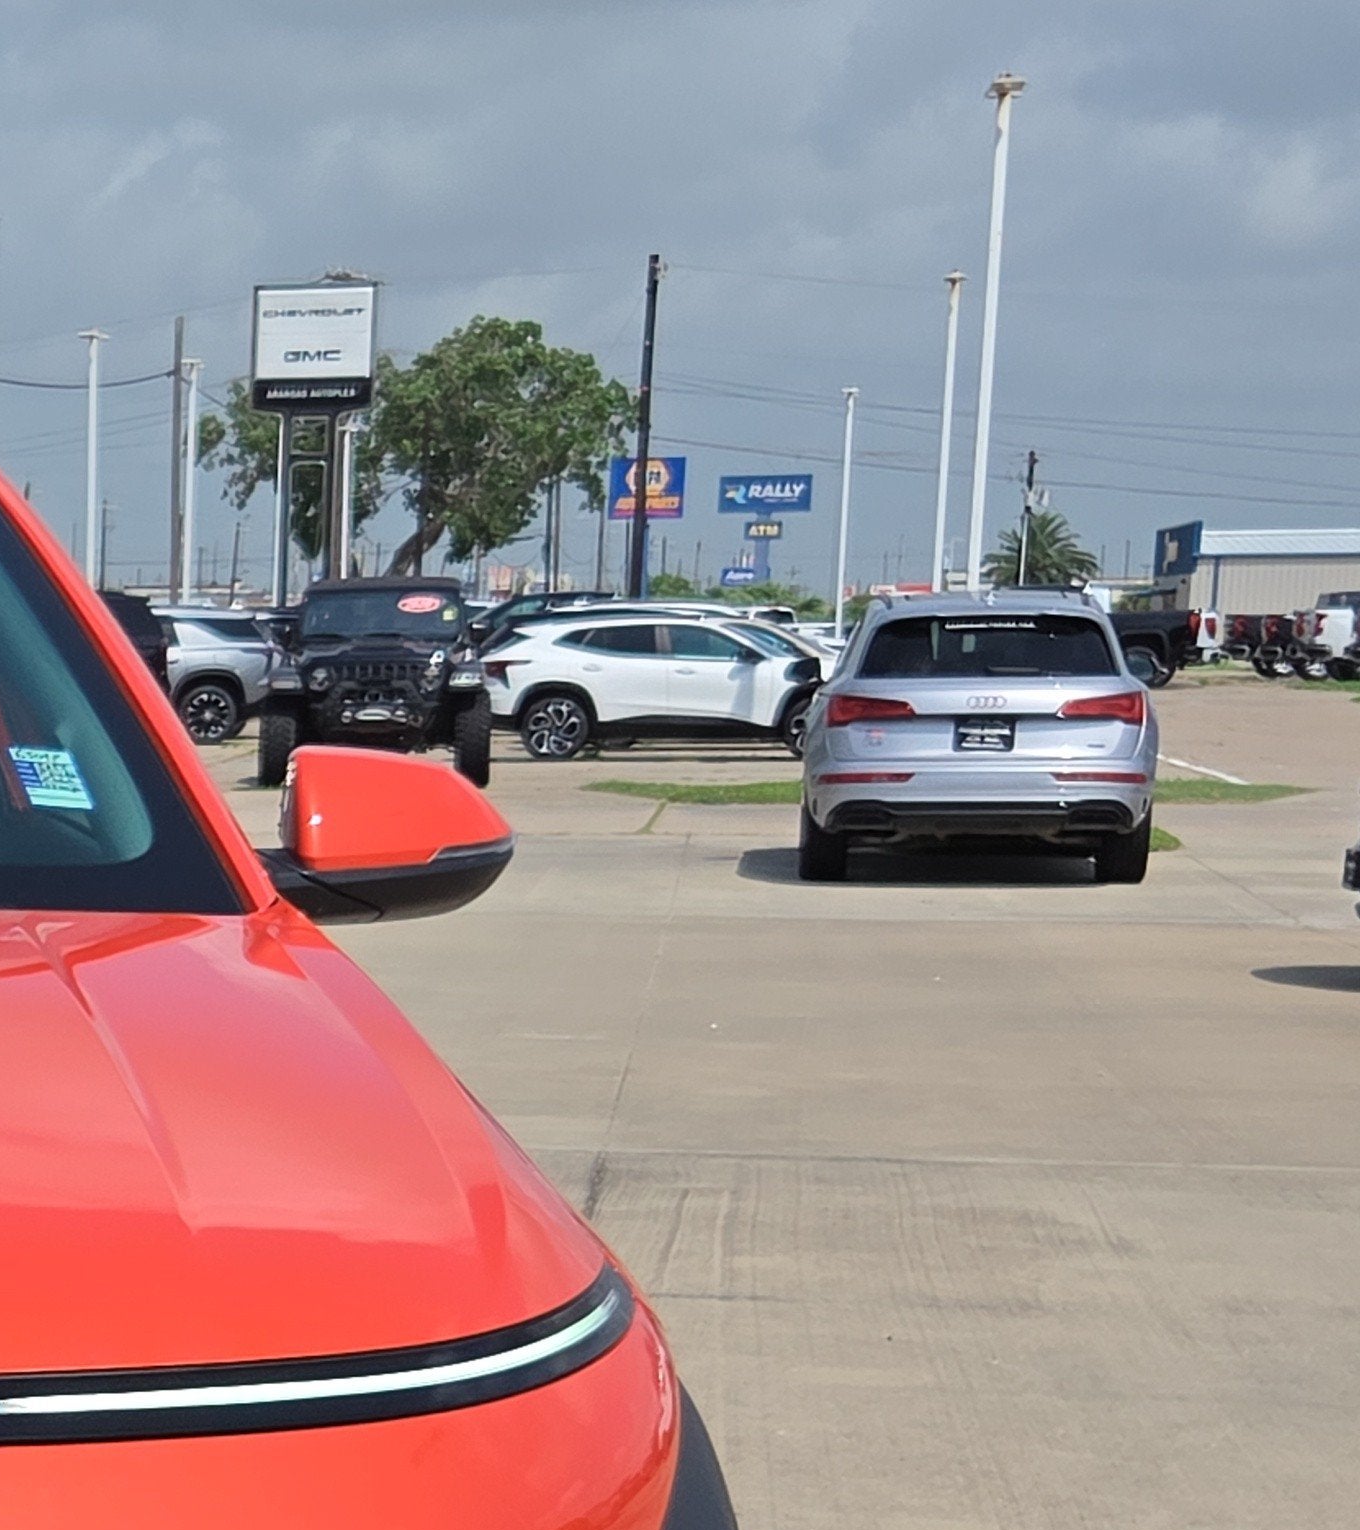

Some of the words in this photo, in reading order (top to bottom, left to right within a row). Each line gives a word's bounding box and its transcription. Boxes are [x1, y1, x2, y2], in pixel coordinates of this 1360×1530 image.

[263, 308, 365, 318] CHEVROLET
[284, 350, 341, 362] GMC
[748, 483, 804, 498] RALLY
[749, 525, 778, 536] ATM
